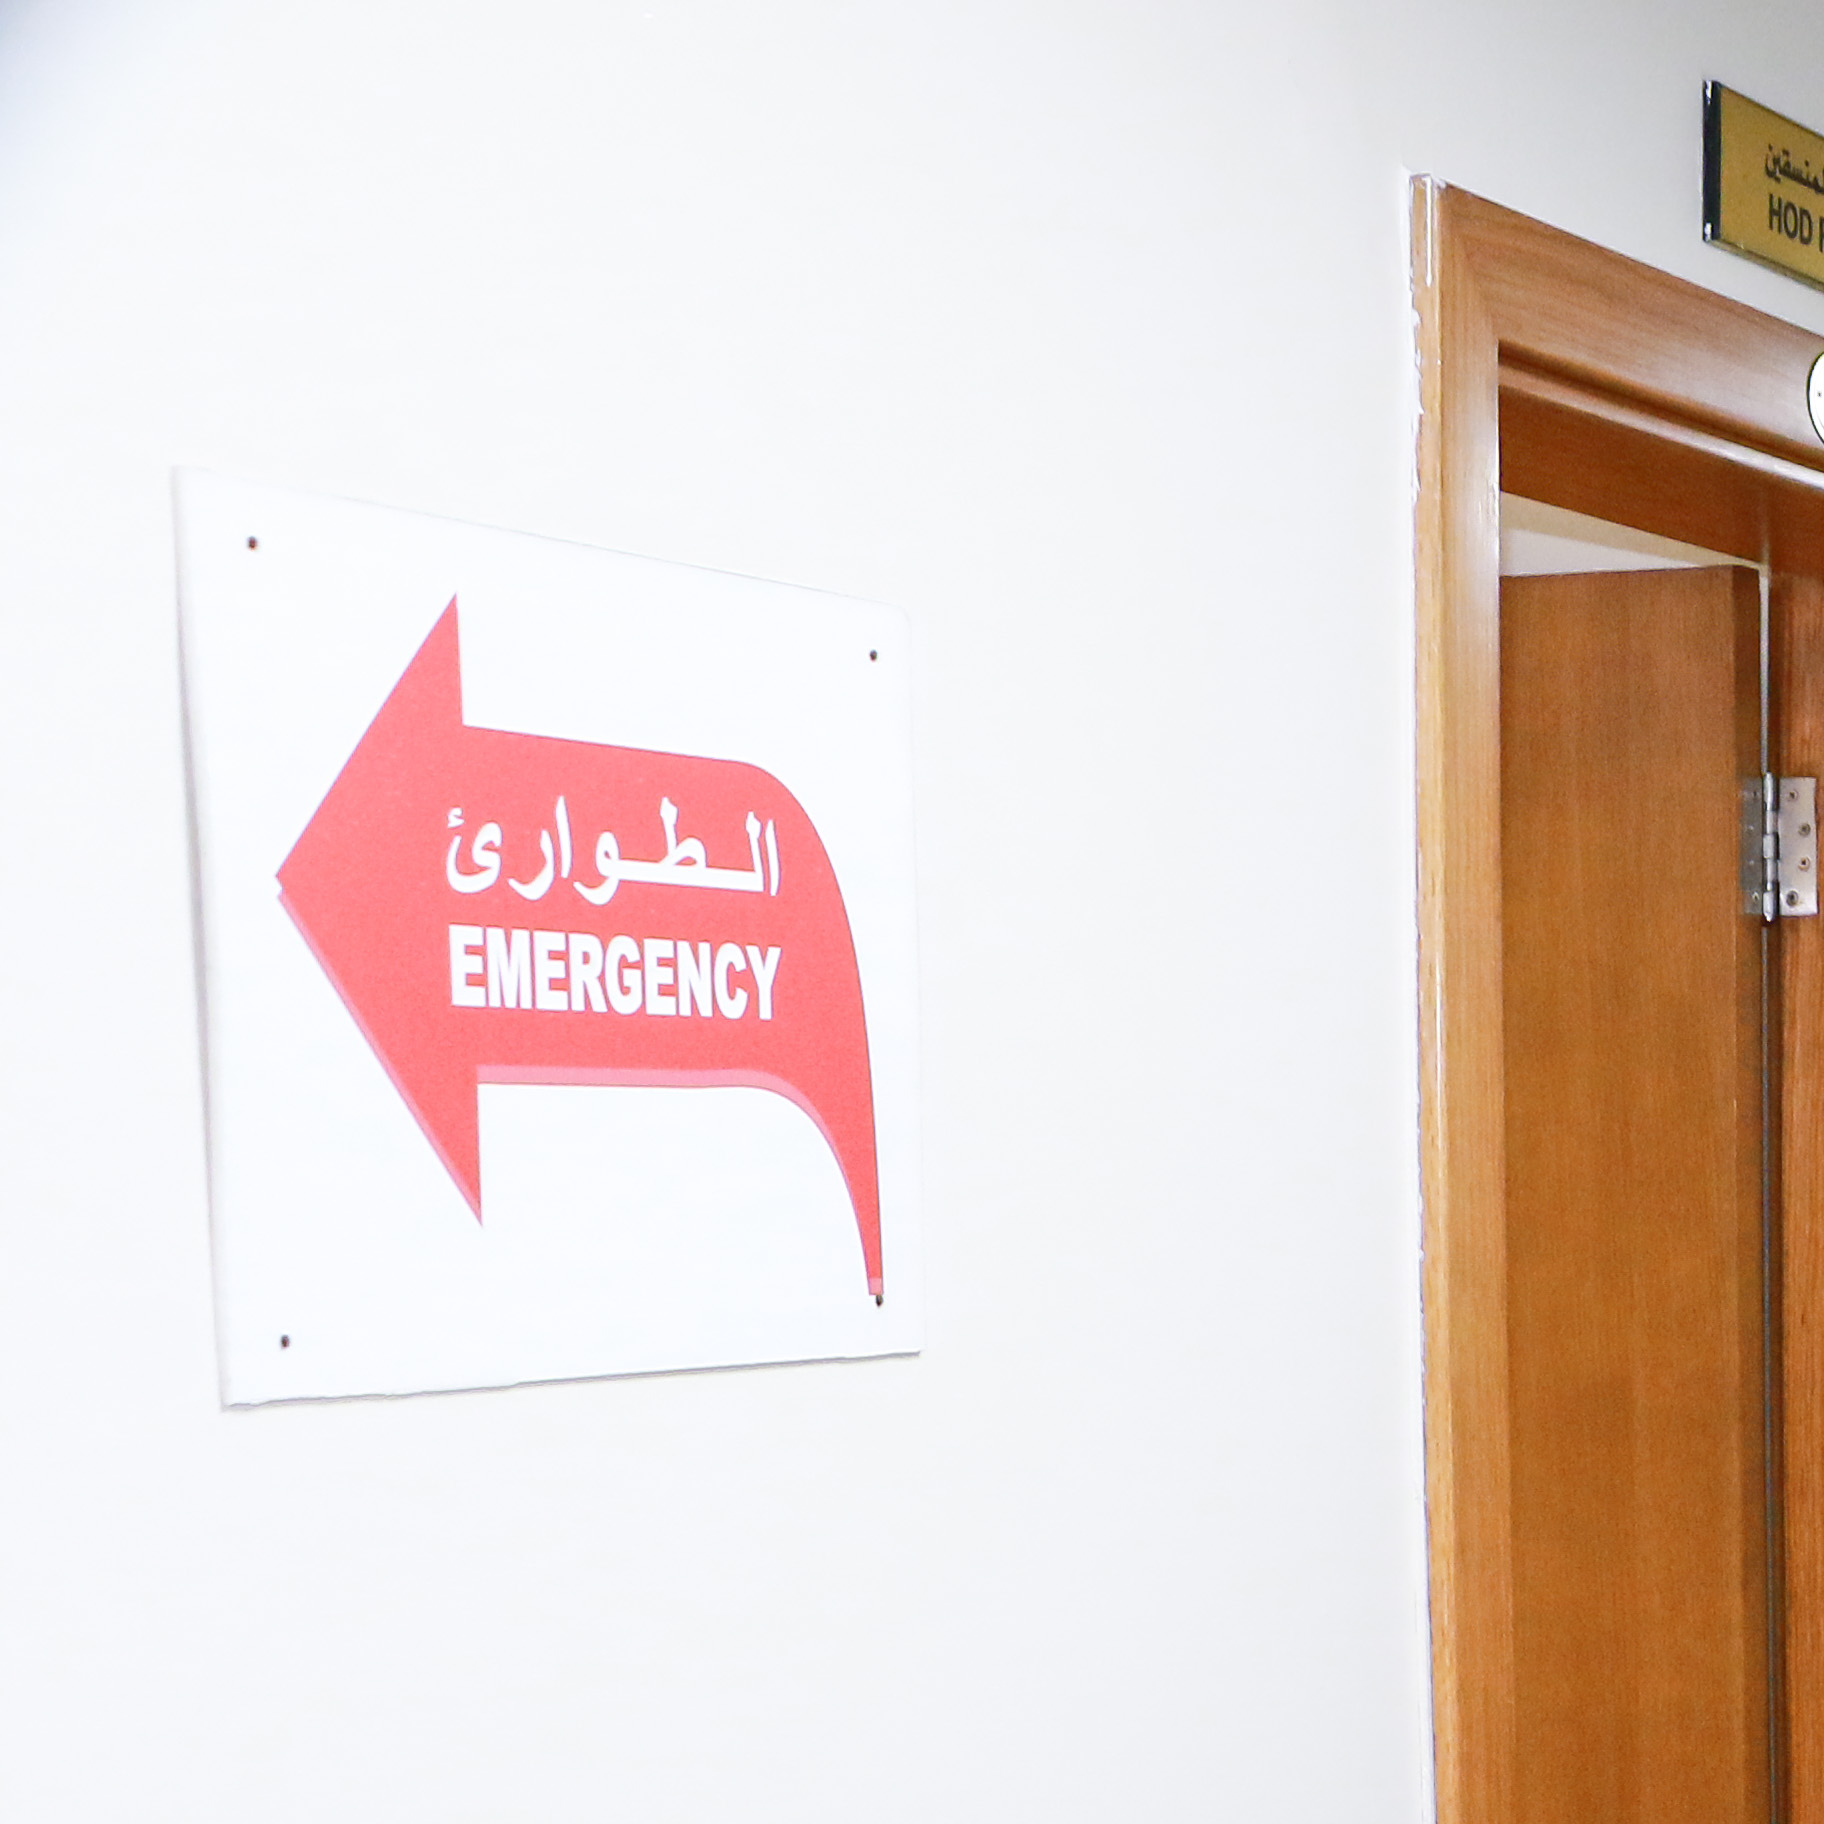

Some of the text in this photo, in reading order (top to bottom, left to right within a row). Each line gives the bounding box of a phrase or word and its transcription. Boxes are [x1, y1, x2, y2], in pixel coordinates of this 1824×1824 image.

[1768, 193, 1814, 246] HOD
[445, 796, 782, 905] الطوارئ
[449, 923, 782, 1021] EMERGENCY
